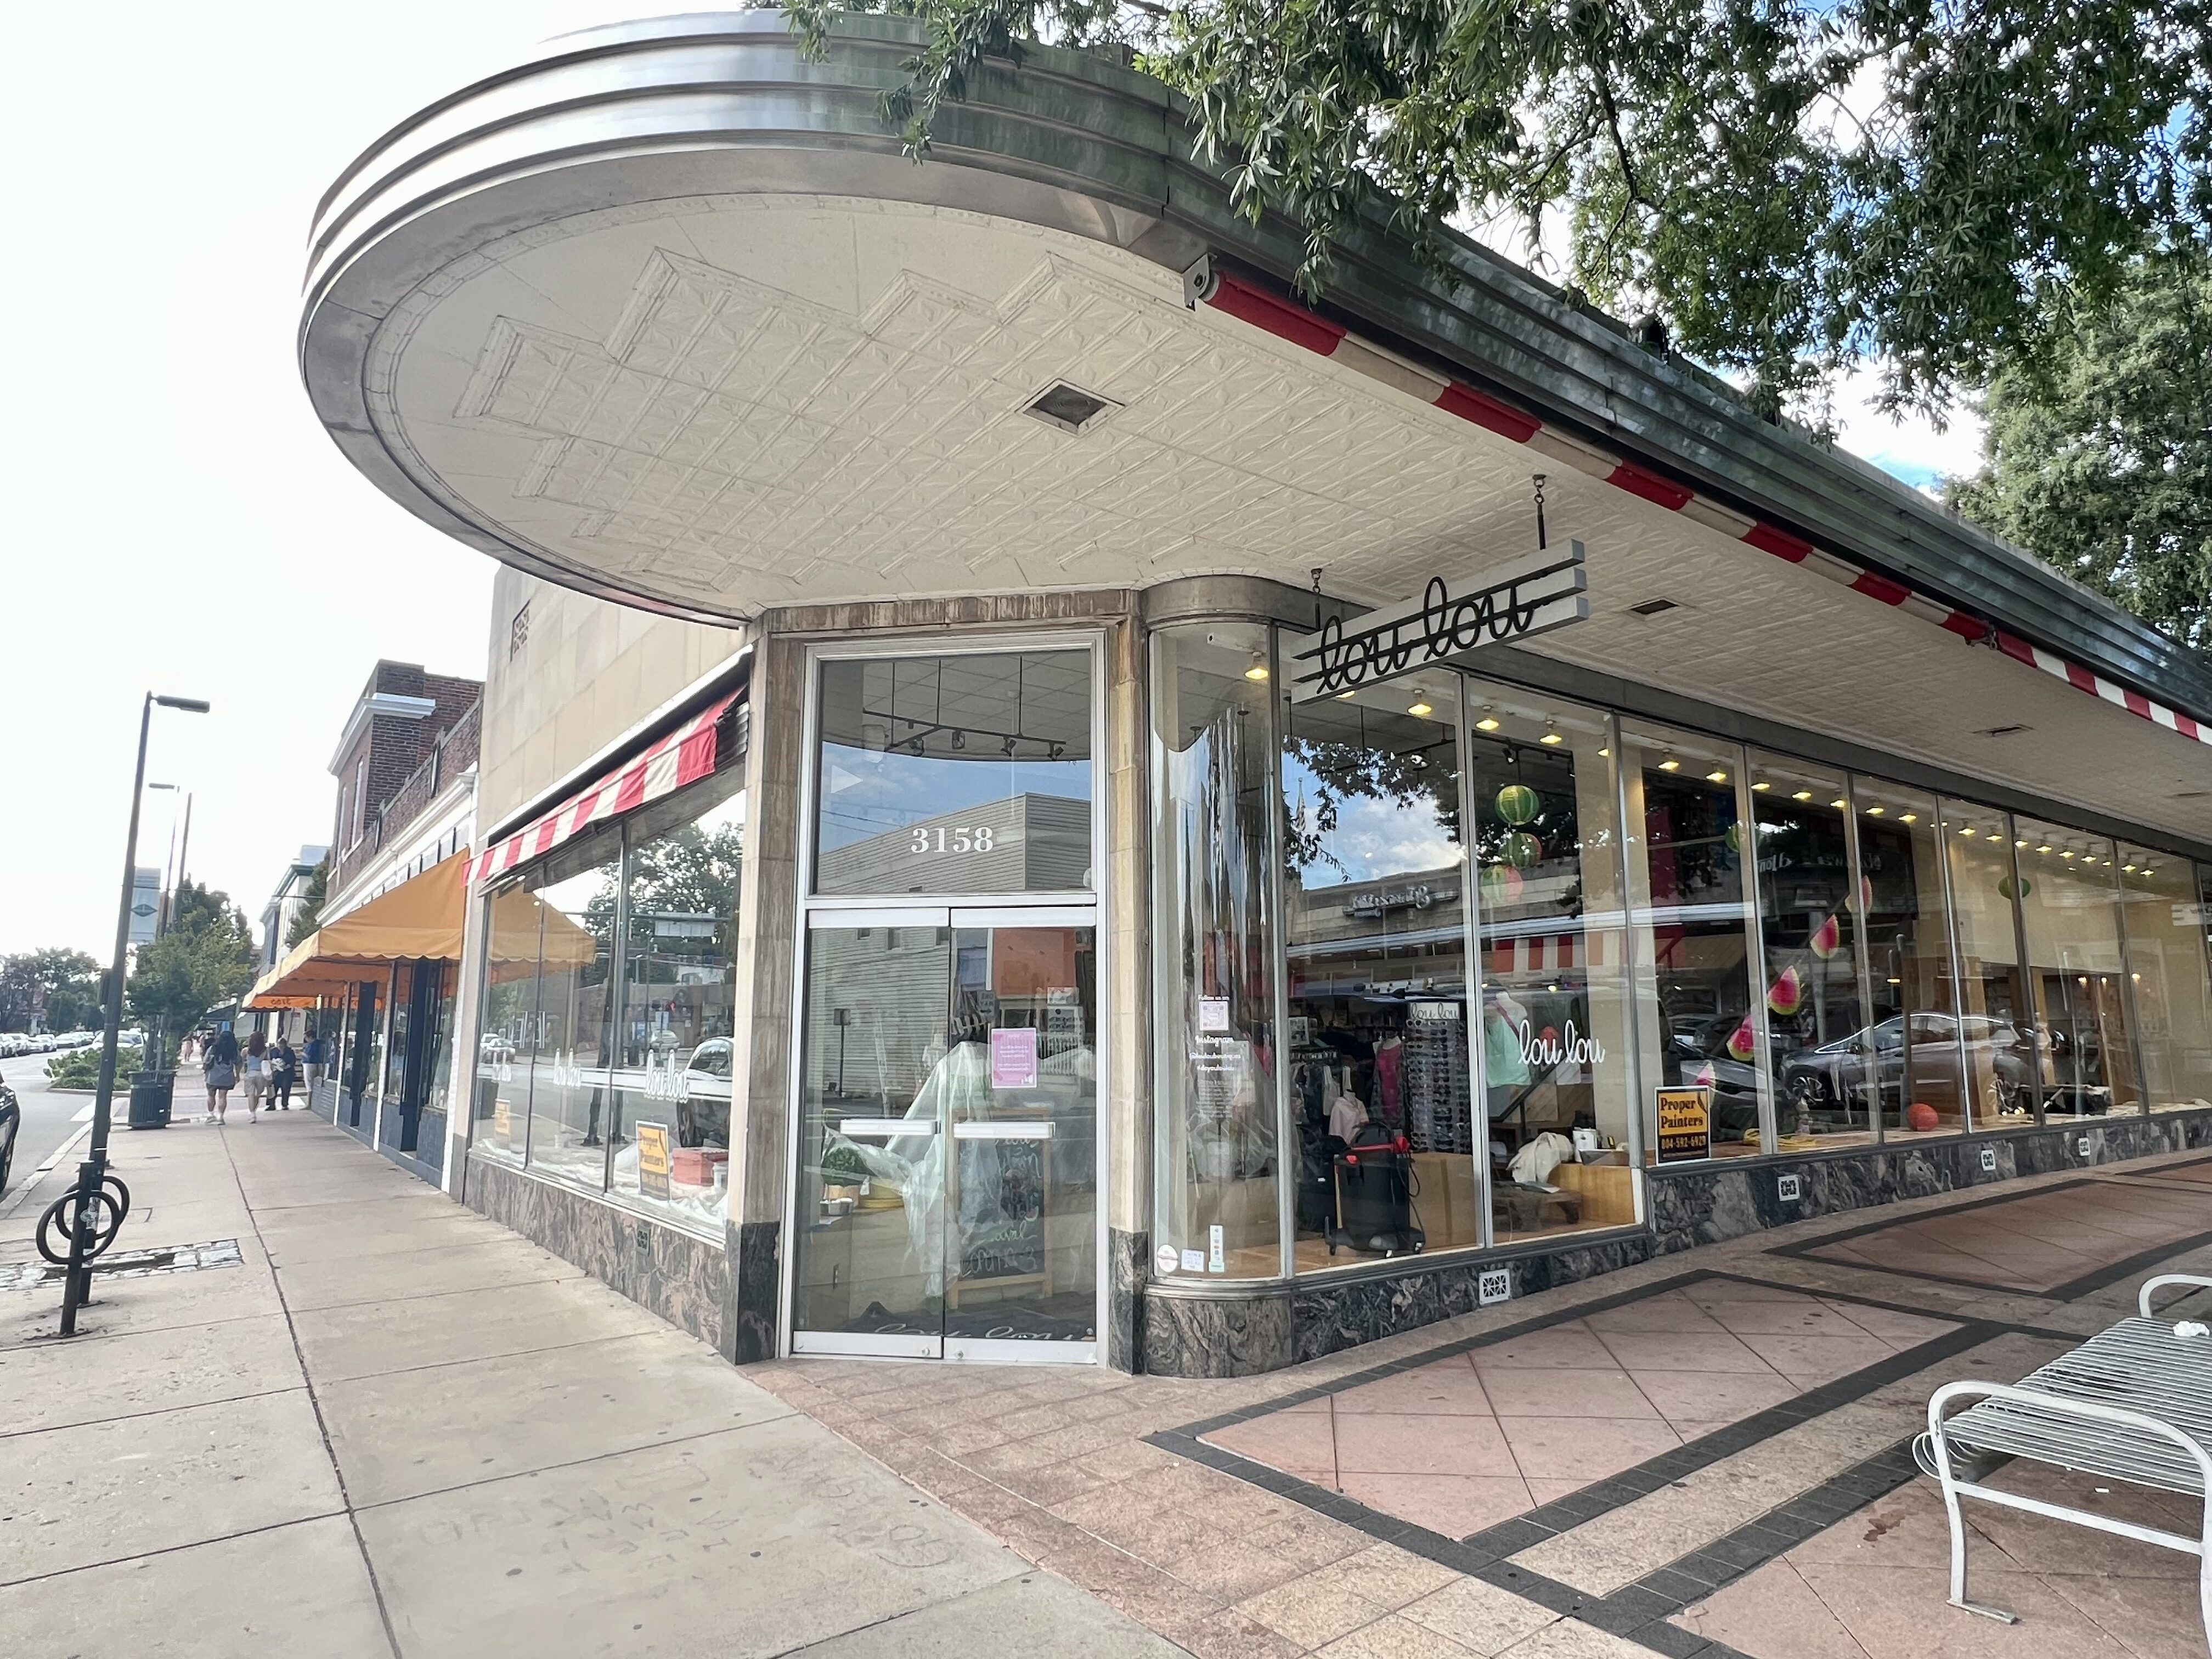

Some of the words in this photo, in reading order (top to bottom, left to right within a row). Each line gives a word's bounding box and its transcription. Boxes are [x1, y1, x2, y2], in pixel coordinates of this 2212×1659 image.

[1317, 615, 1412, 691] lou
[1424, 577, 1534, 661] lou
[910, 826, 994, 853] 3158
[1410, 1003, 1435, 1019] lou
[1437, 1002, 1459, 1019] lou
[1195, 1034, 1234, 1047] Instagram
[1517, 1019, 1563, 1065] lou
[1563, 1019, 1606, 1064] lou
[1660, 1097, 1696, 1114] Proper
[1661, 1114, 1703, 1129] Painters
